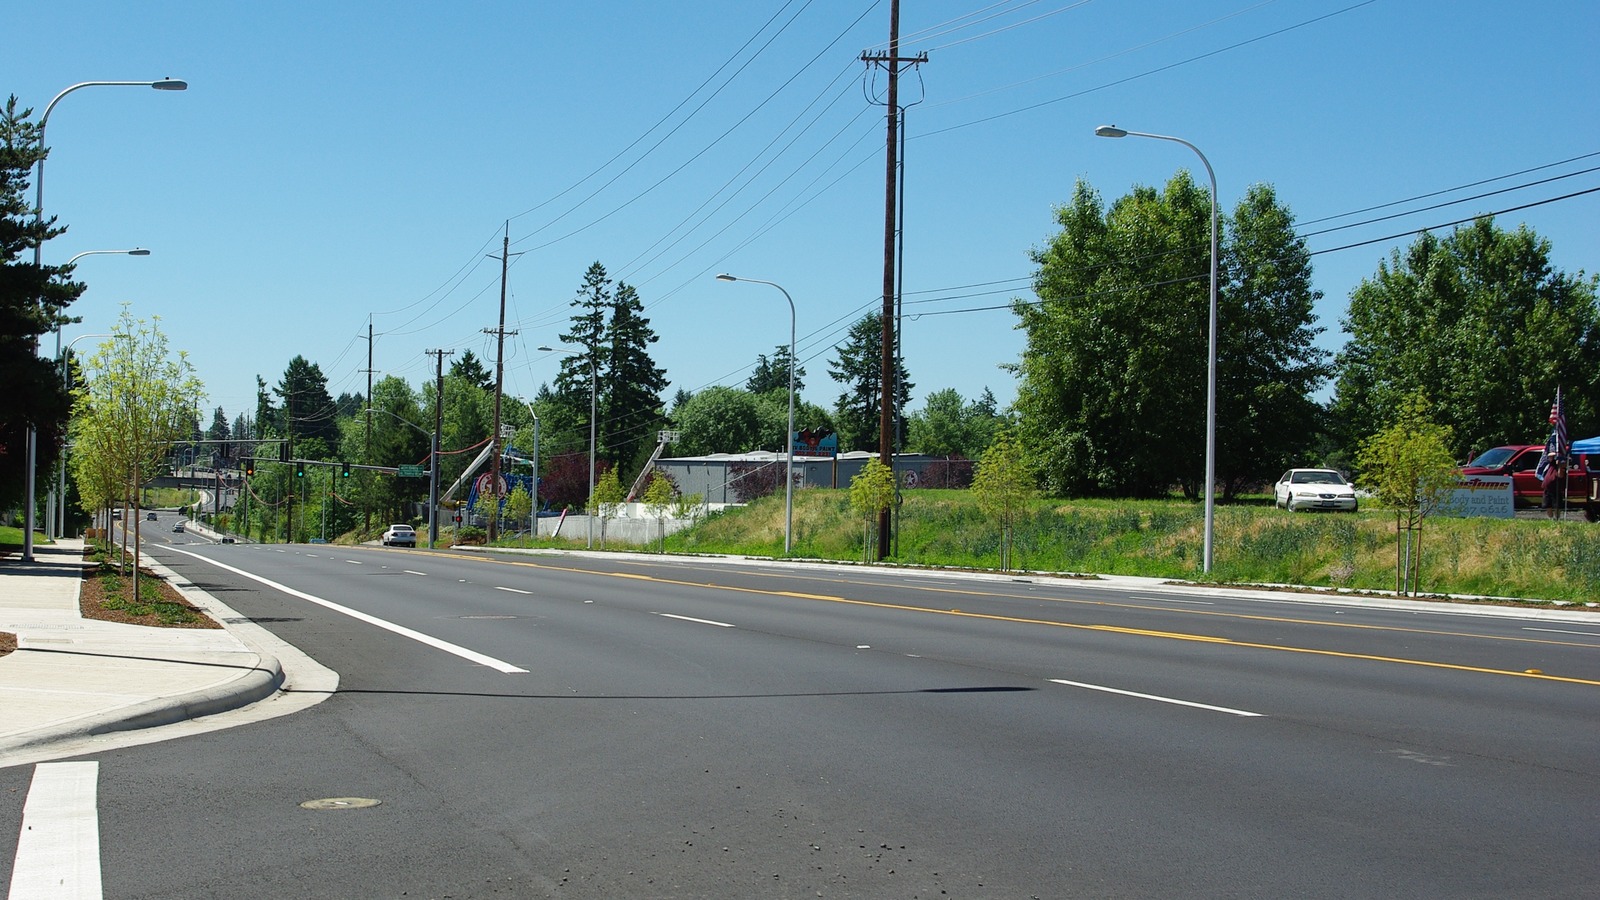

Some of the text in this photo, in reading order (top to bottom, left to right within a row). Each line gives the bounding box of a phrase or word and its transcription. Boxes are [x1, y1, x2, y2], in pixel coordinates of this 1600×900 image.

[1450, 494, 1471, 506] Body
[1471, 494, 1487, 505] and
[1488, 494, 1510, 505] Paint
[1480, 505, 1508, 514] 0616
